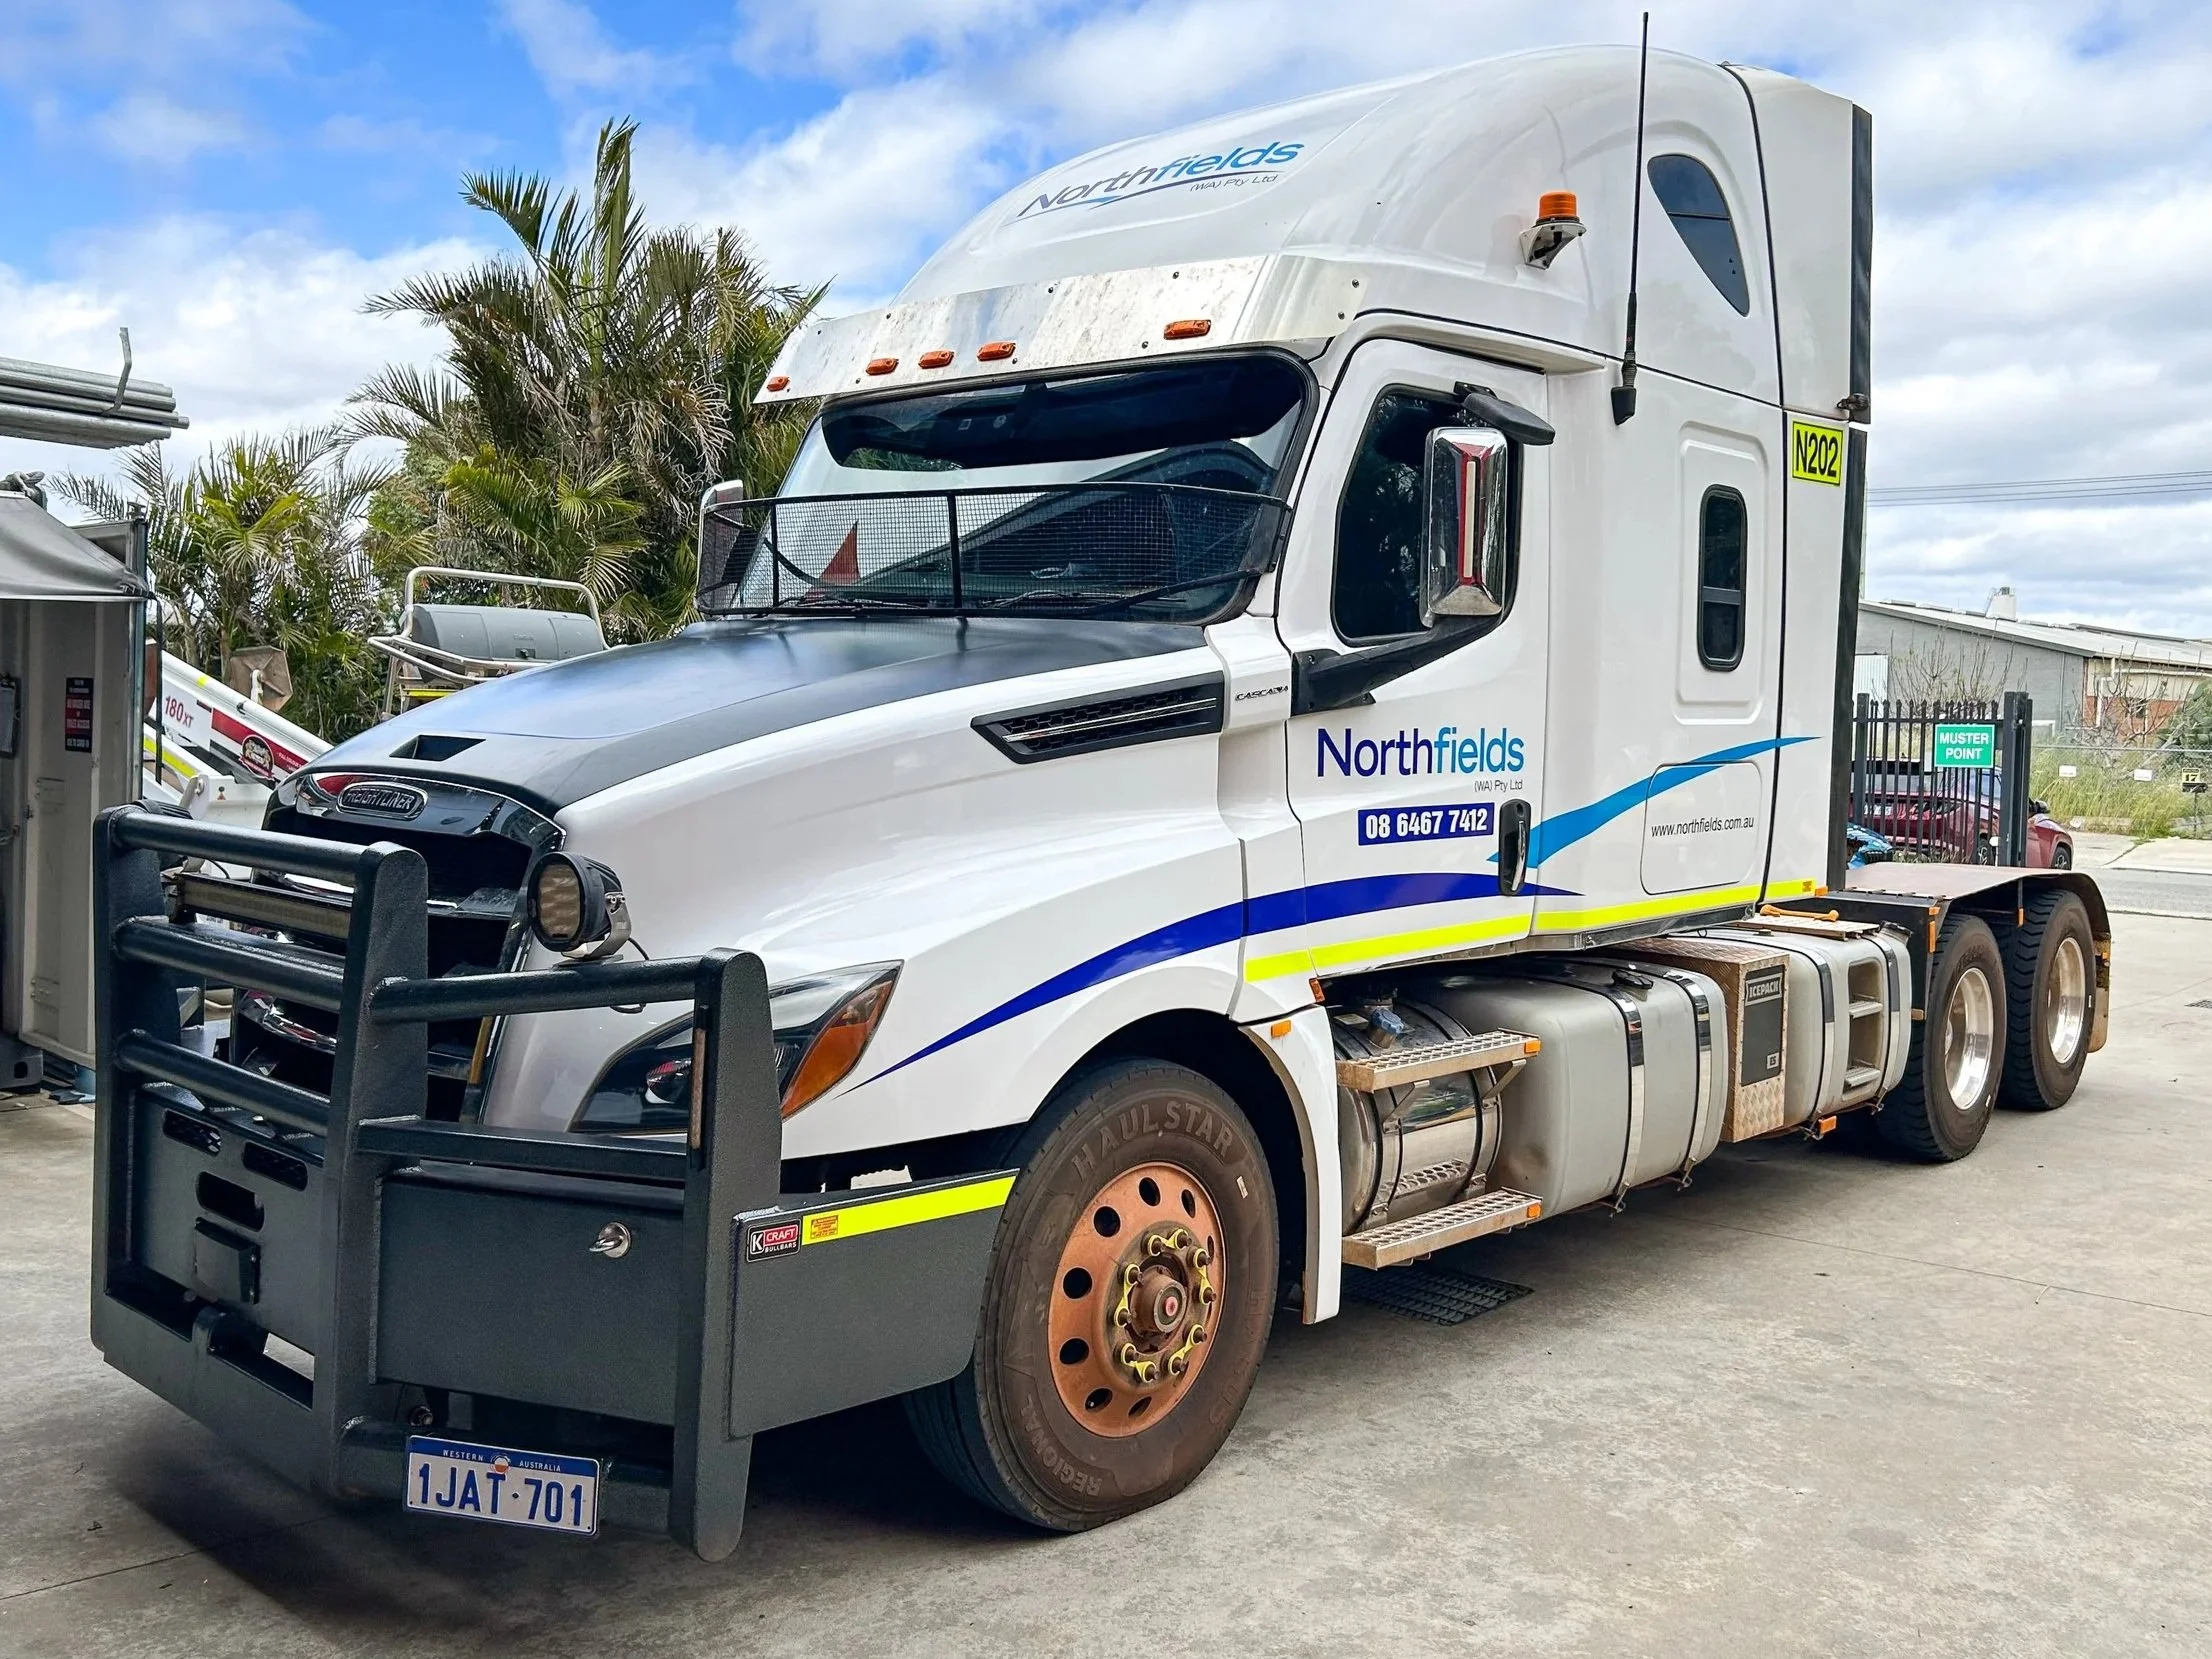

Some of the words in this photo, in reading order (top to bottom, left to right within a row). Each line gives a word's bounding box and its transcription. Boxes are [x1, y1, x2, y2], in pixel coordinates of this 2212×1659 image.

[1017, 141, 1305, 218] Northfields
[1190, 181, 1222, 192] (WA)
[1223, 178, 1250, 187] Pty
[1251, 174, 1279, 184] Ltd
[1796, 429, 1838, 478] N202
[165, 696, 184, 722] 180
[1939, 732, 1989, 745] MUSTER
[1317, 726, 1525, 778] Northfields
[1945, 747, 1983, 760] POINT
[1474, 780, 1493, 793] (WA)
[1494, 780, 1508, 793] Pty
[1509, 779, 1523, 790] Ltd
[2185, 774, 2198, 782] 17
[344, 788, 415, 810] FREIGHTLINER
[1365, 813, 1391, 840] 08
[1396, 810, 1444, 837] 6467
[1449, 807, 1488, 833] 7412
[1651, 816, 1755, 838] www.northfields.com.au
[1749, 980, 1779, 997] ICEPACK
[1072, 1104, 1159, 1182] HAUL
[1164, 1100, 1233, 1157] STAR
[752, 1233, 763, 1252] K
[766, 1228, 796, 1242] CRAFT
[765, 1242, 797, 1253] BULLBARS
[1020, 1394, 1102, 1496] REGIONAL
[443, 1450, 484, 1462] WESTERN
[519, 1460, 561, 1472] AUSTRALIA
[524, 1478, 582, 1526] 701
